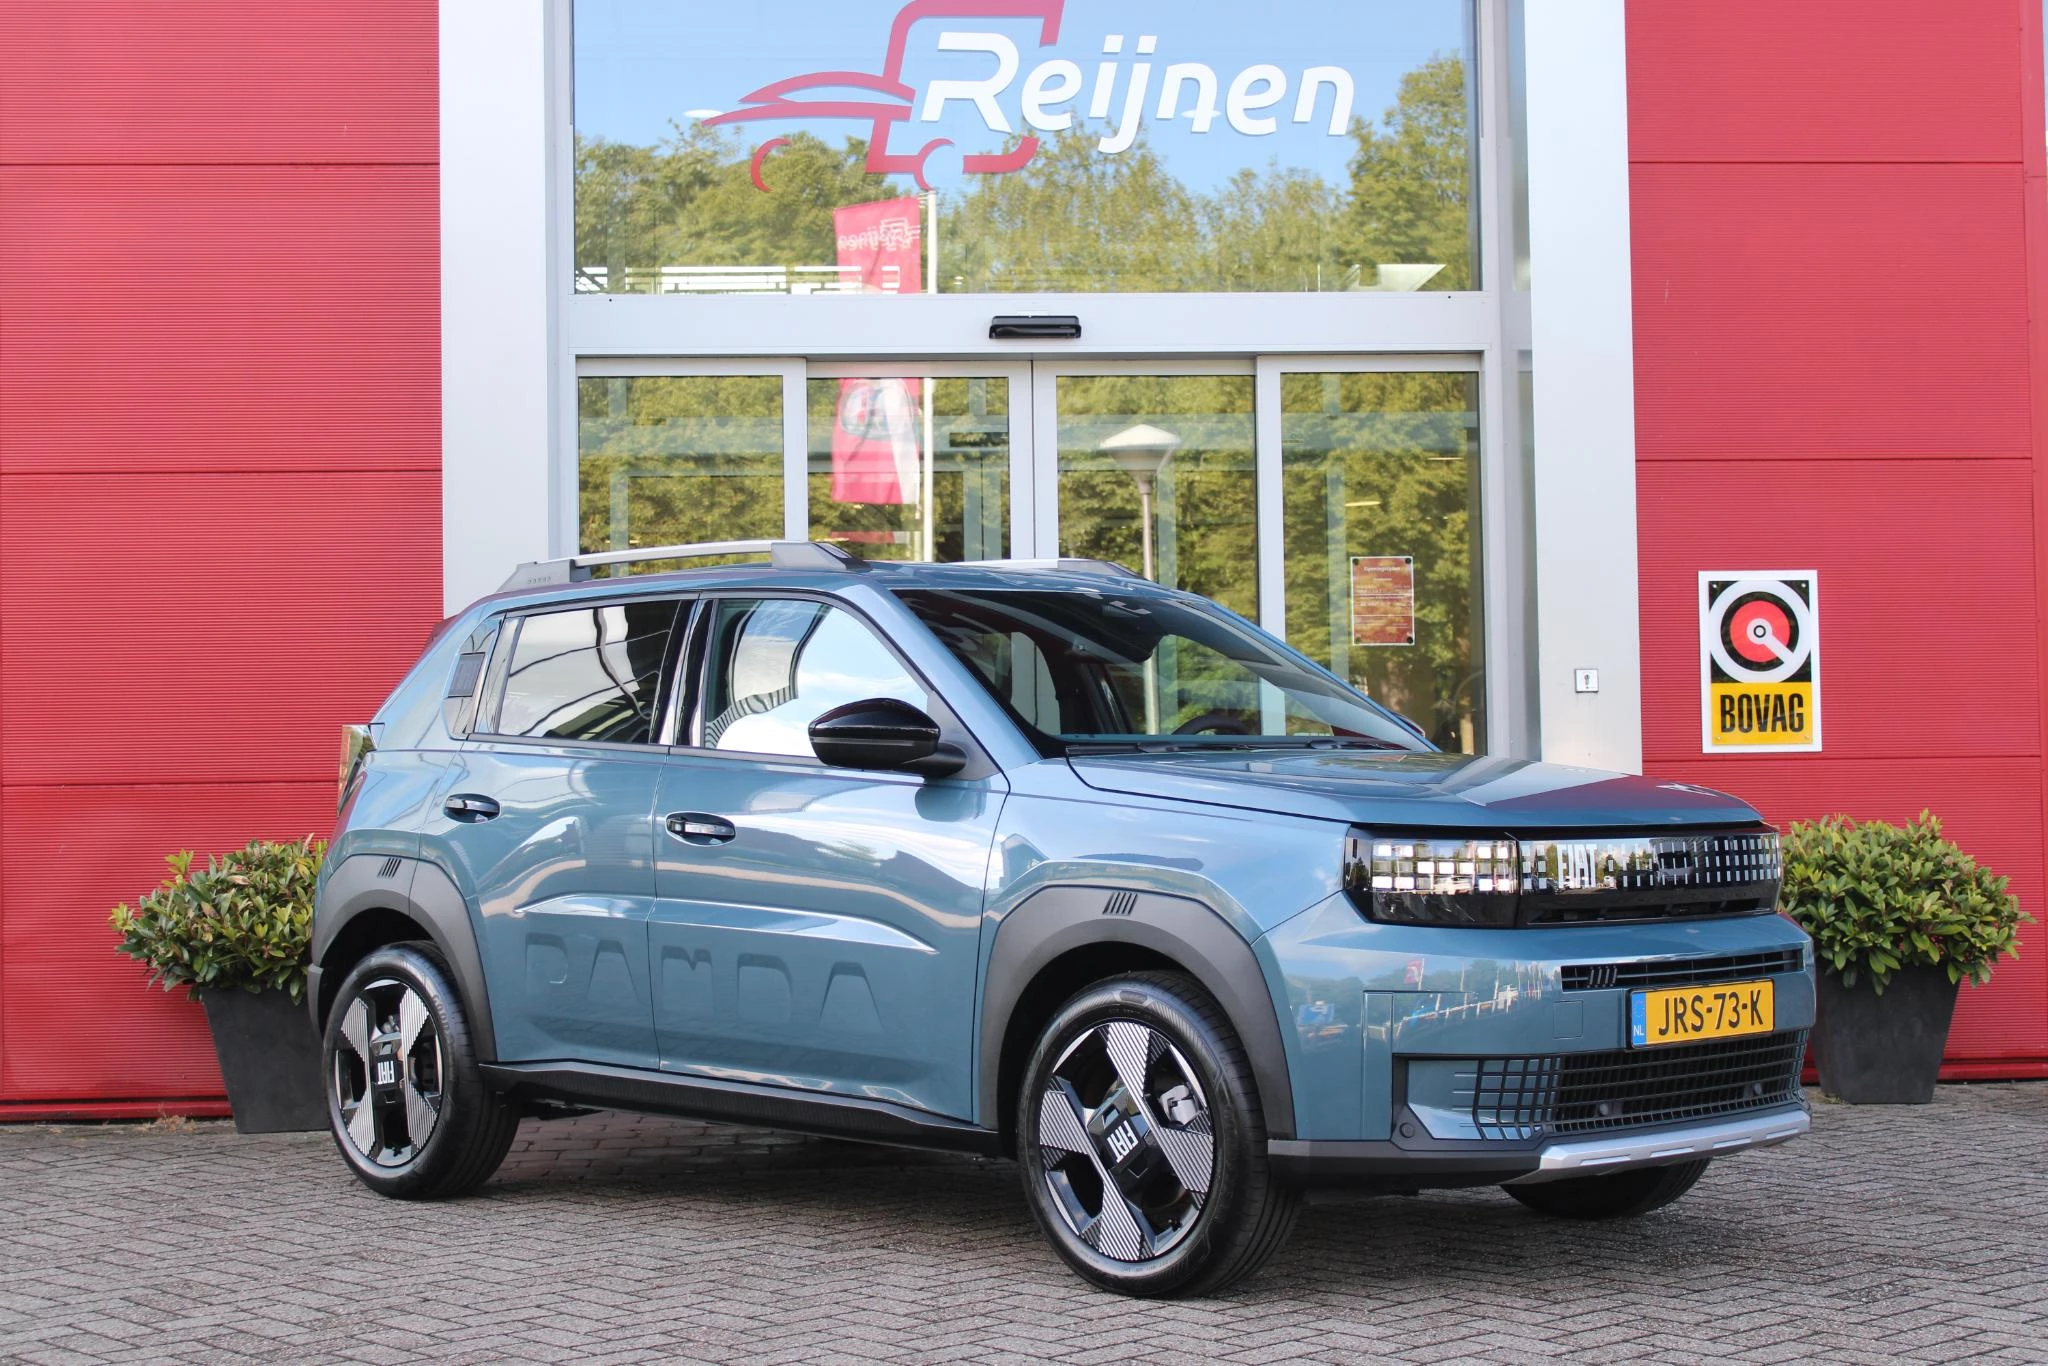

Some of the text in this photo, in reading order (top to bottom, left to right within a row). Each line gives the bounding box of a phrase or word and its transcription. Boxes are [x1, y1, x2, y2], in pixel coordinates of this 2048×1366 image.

[920, 32, 1354, 153] Reijnen
[1719, 693, 1804, 733] BOVAG
[1556, 843, 1598, 889] FIAT
[524, 931, 886, 1034] PANDA
[1633, 1024, 1645, 1037] NL
[1658, 989, 1764, 1036] JRS-73-K
[377, 1060, 395, 1085] FIAT
[1106, 1119, 1139, 1164] FIAT
